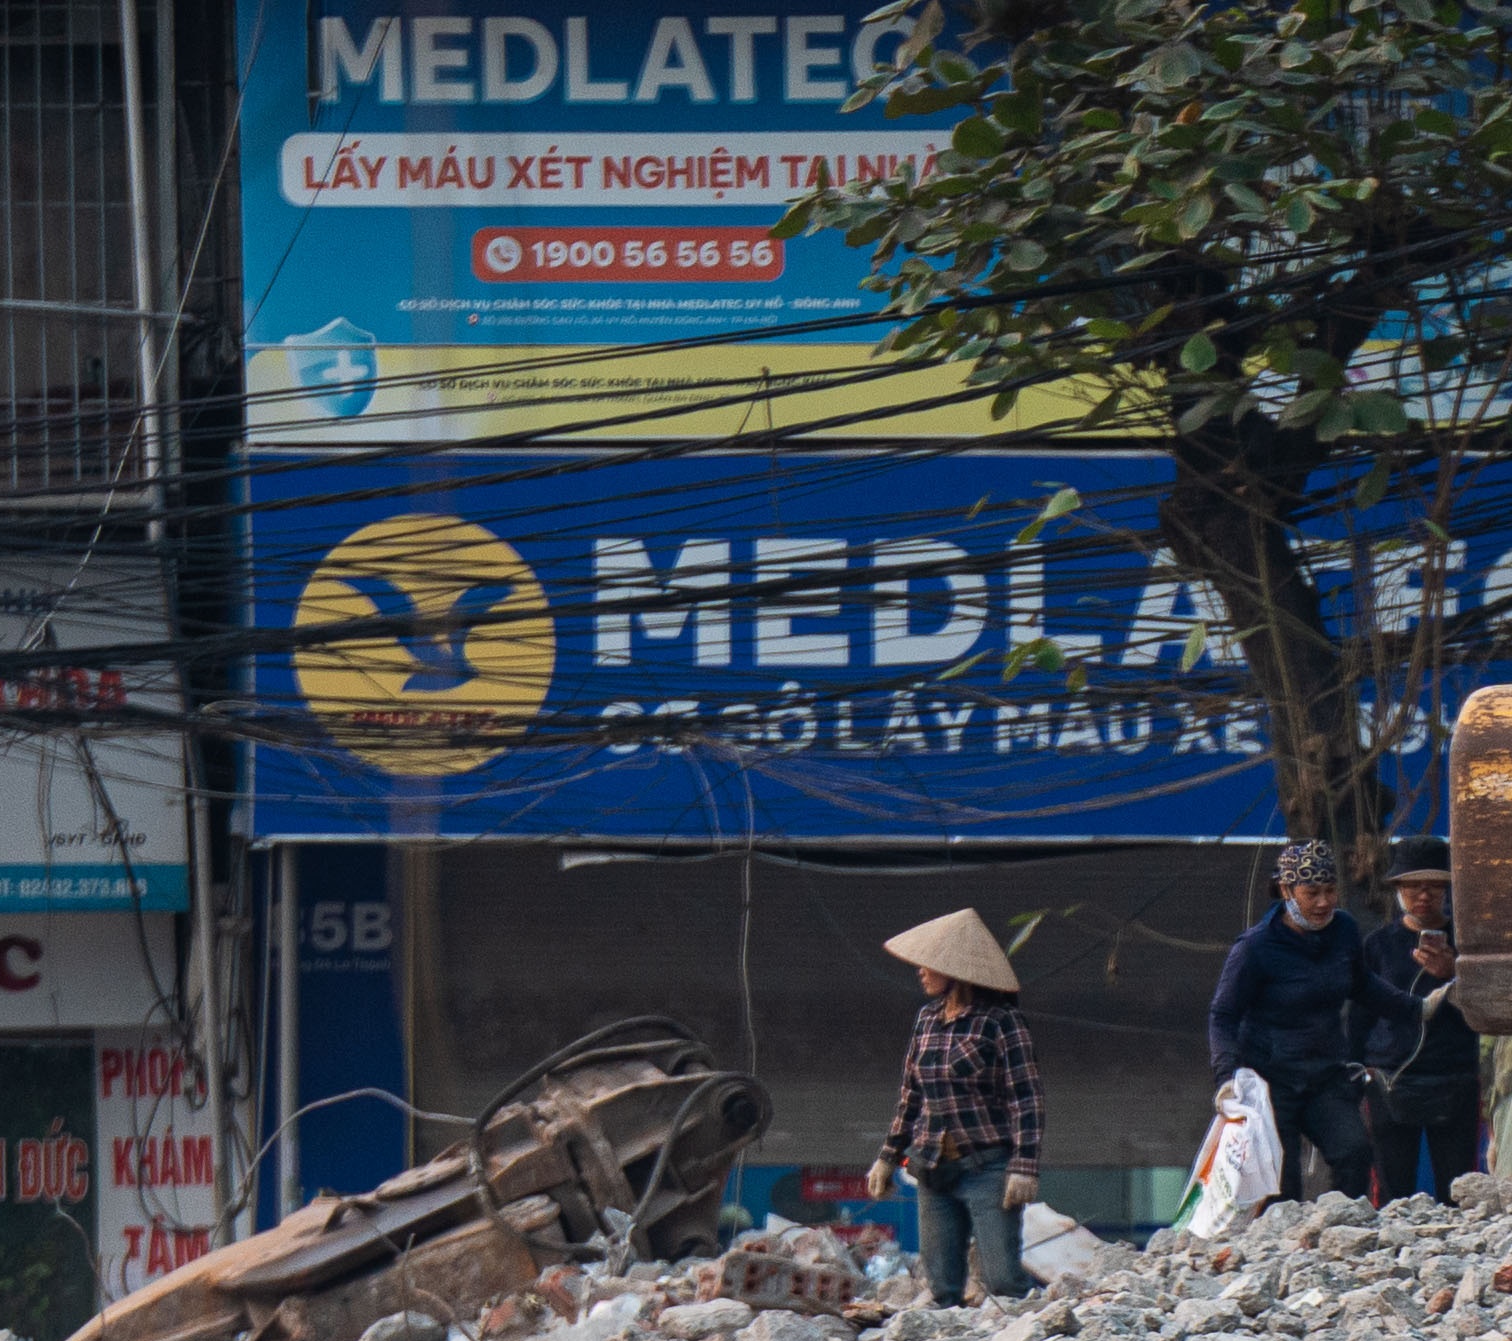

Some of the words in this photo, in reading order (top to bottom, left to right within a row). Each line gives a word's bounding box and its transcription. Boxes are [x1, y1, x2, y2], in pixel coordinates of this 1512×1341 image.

[303, 141, 387, 190] LẤY
[397, 145, 494, 190] MÁU
[506, 145, 592, 190] XÉT
[602, 145, 770, 200] NGHIỆM
[531, 239, 615, 269] 1900
[624, 239, 669, 269] 56
[676, 239, 721, 269] 56
[729, 239, 774, 268] 56
[18, 1116, 88, 1201] ĐỨC
[112, 1126, 215, 1187] KHÁM
[123, 1213, 210, 1276] TÂM
